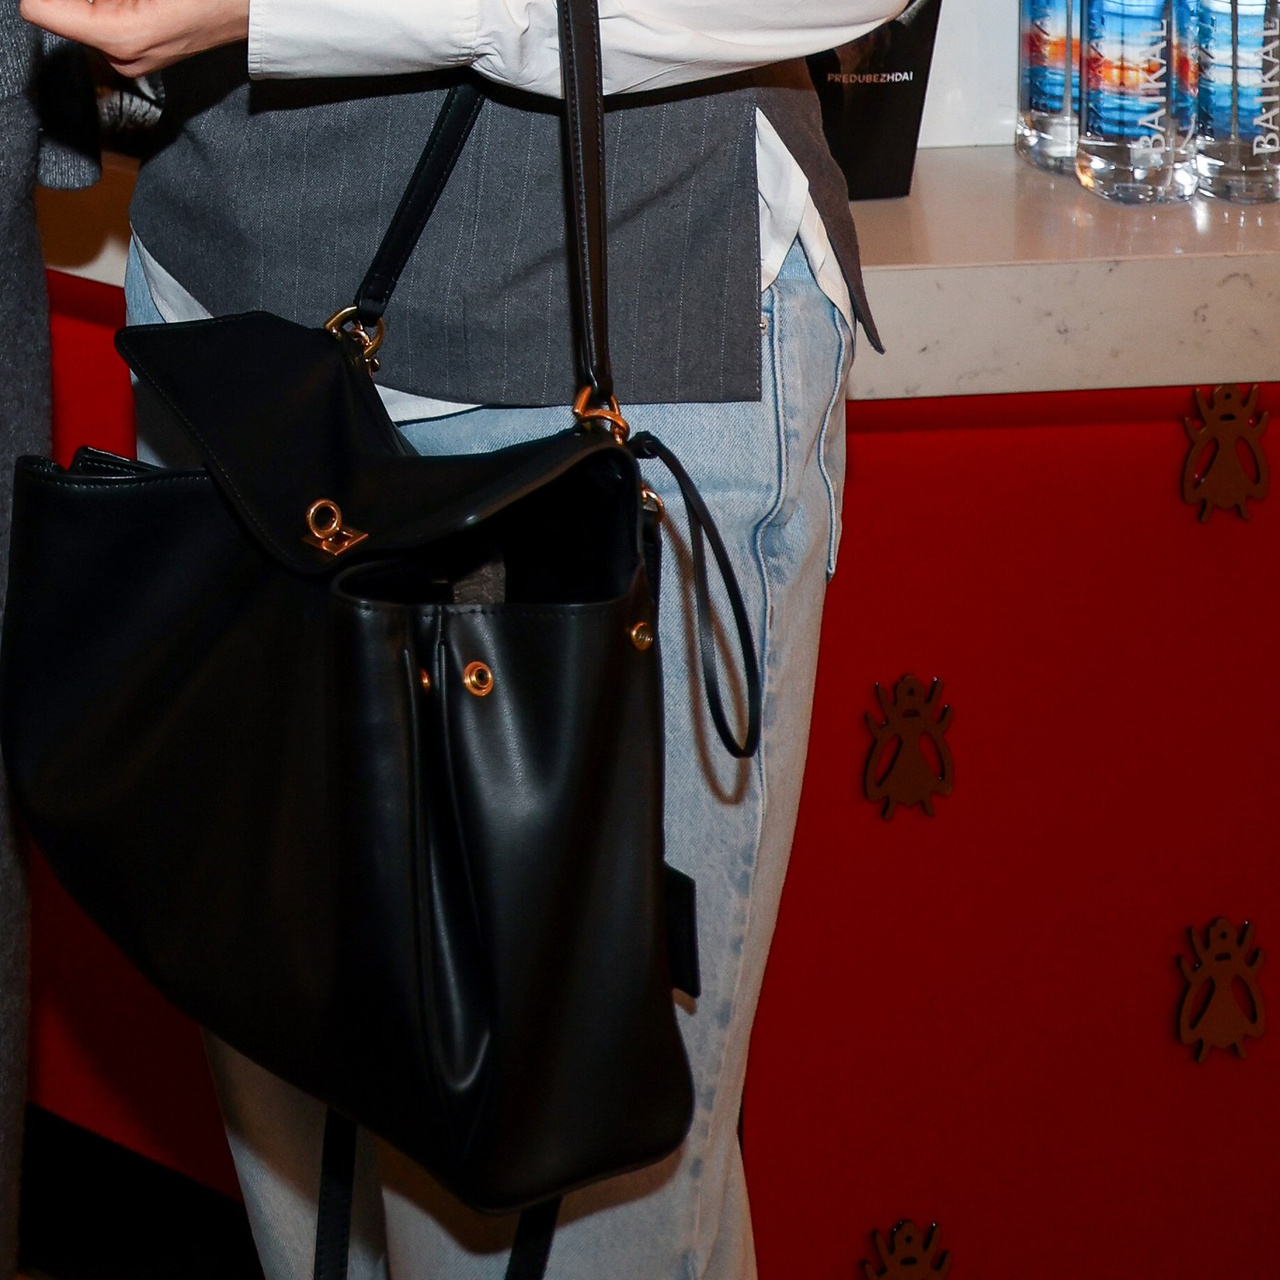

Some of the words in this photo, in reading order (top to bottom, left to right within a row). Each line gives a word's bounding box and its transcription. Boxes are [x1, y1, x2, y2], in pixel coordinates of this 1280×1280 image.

[826, 71, 914, 84] PREDUBEZHDAI
[1137, 18, 1167, 155] BAIKAL
[1252, 17, 1280, 157] BAIKAL
